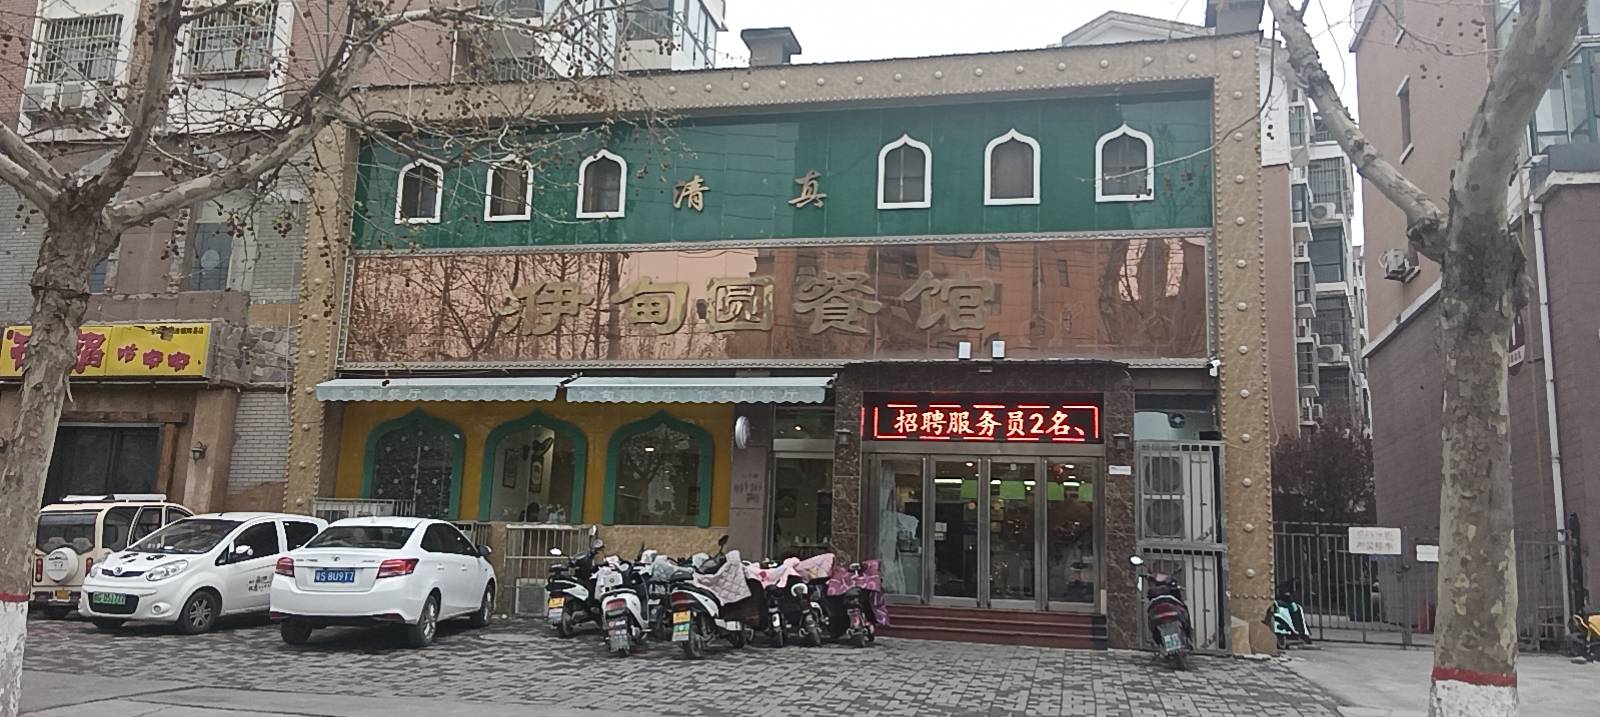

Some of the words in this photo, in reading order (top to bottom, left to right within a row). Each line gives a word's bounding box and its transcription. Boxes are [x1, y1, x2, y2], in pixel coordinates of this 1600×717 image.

[672, 170, 828, 212] 清真
[496, 270, 997, 336] 伊甸圆餐馆
[893, 408, 1086, 437] 招聘服务员2名、
